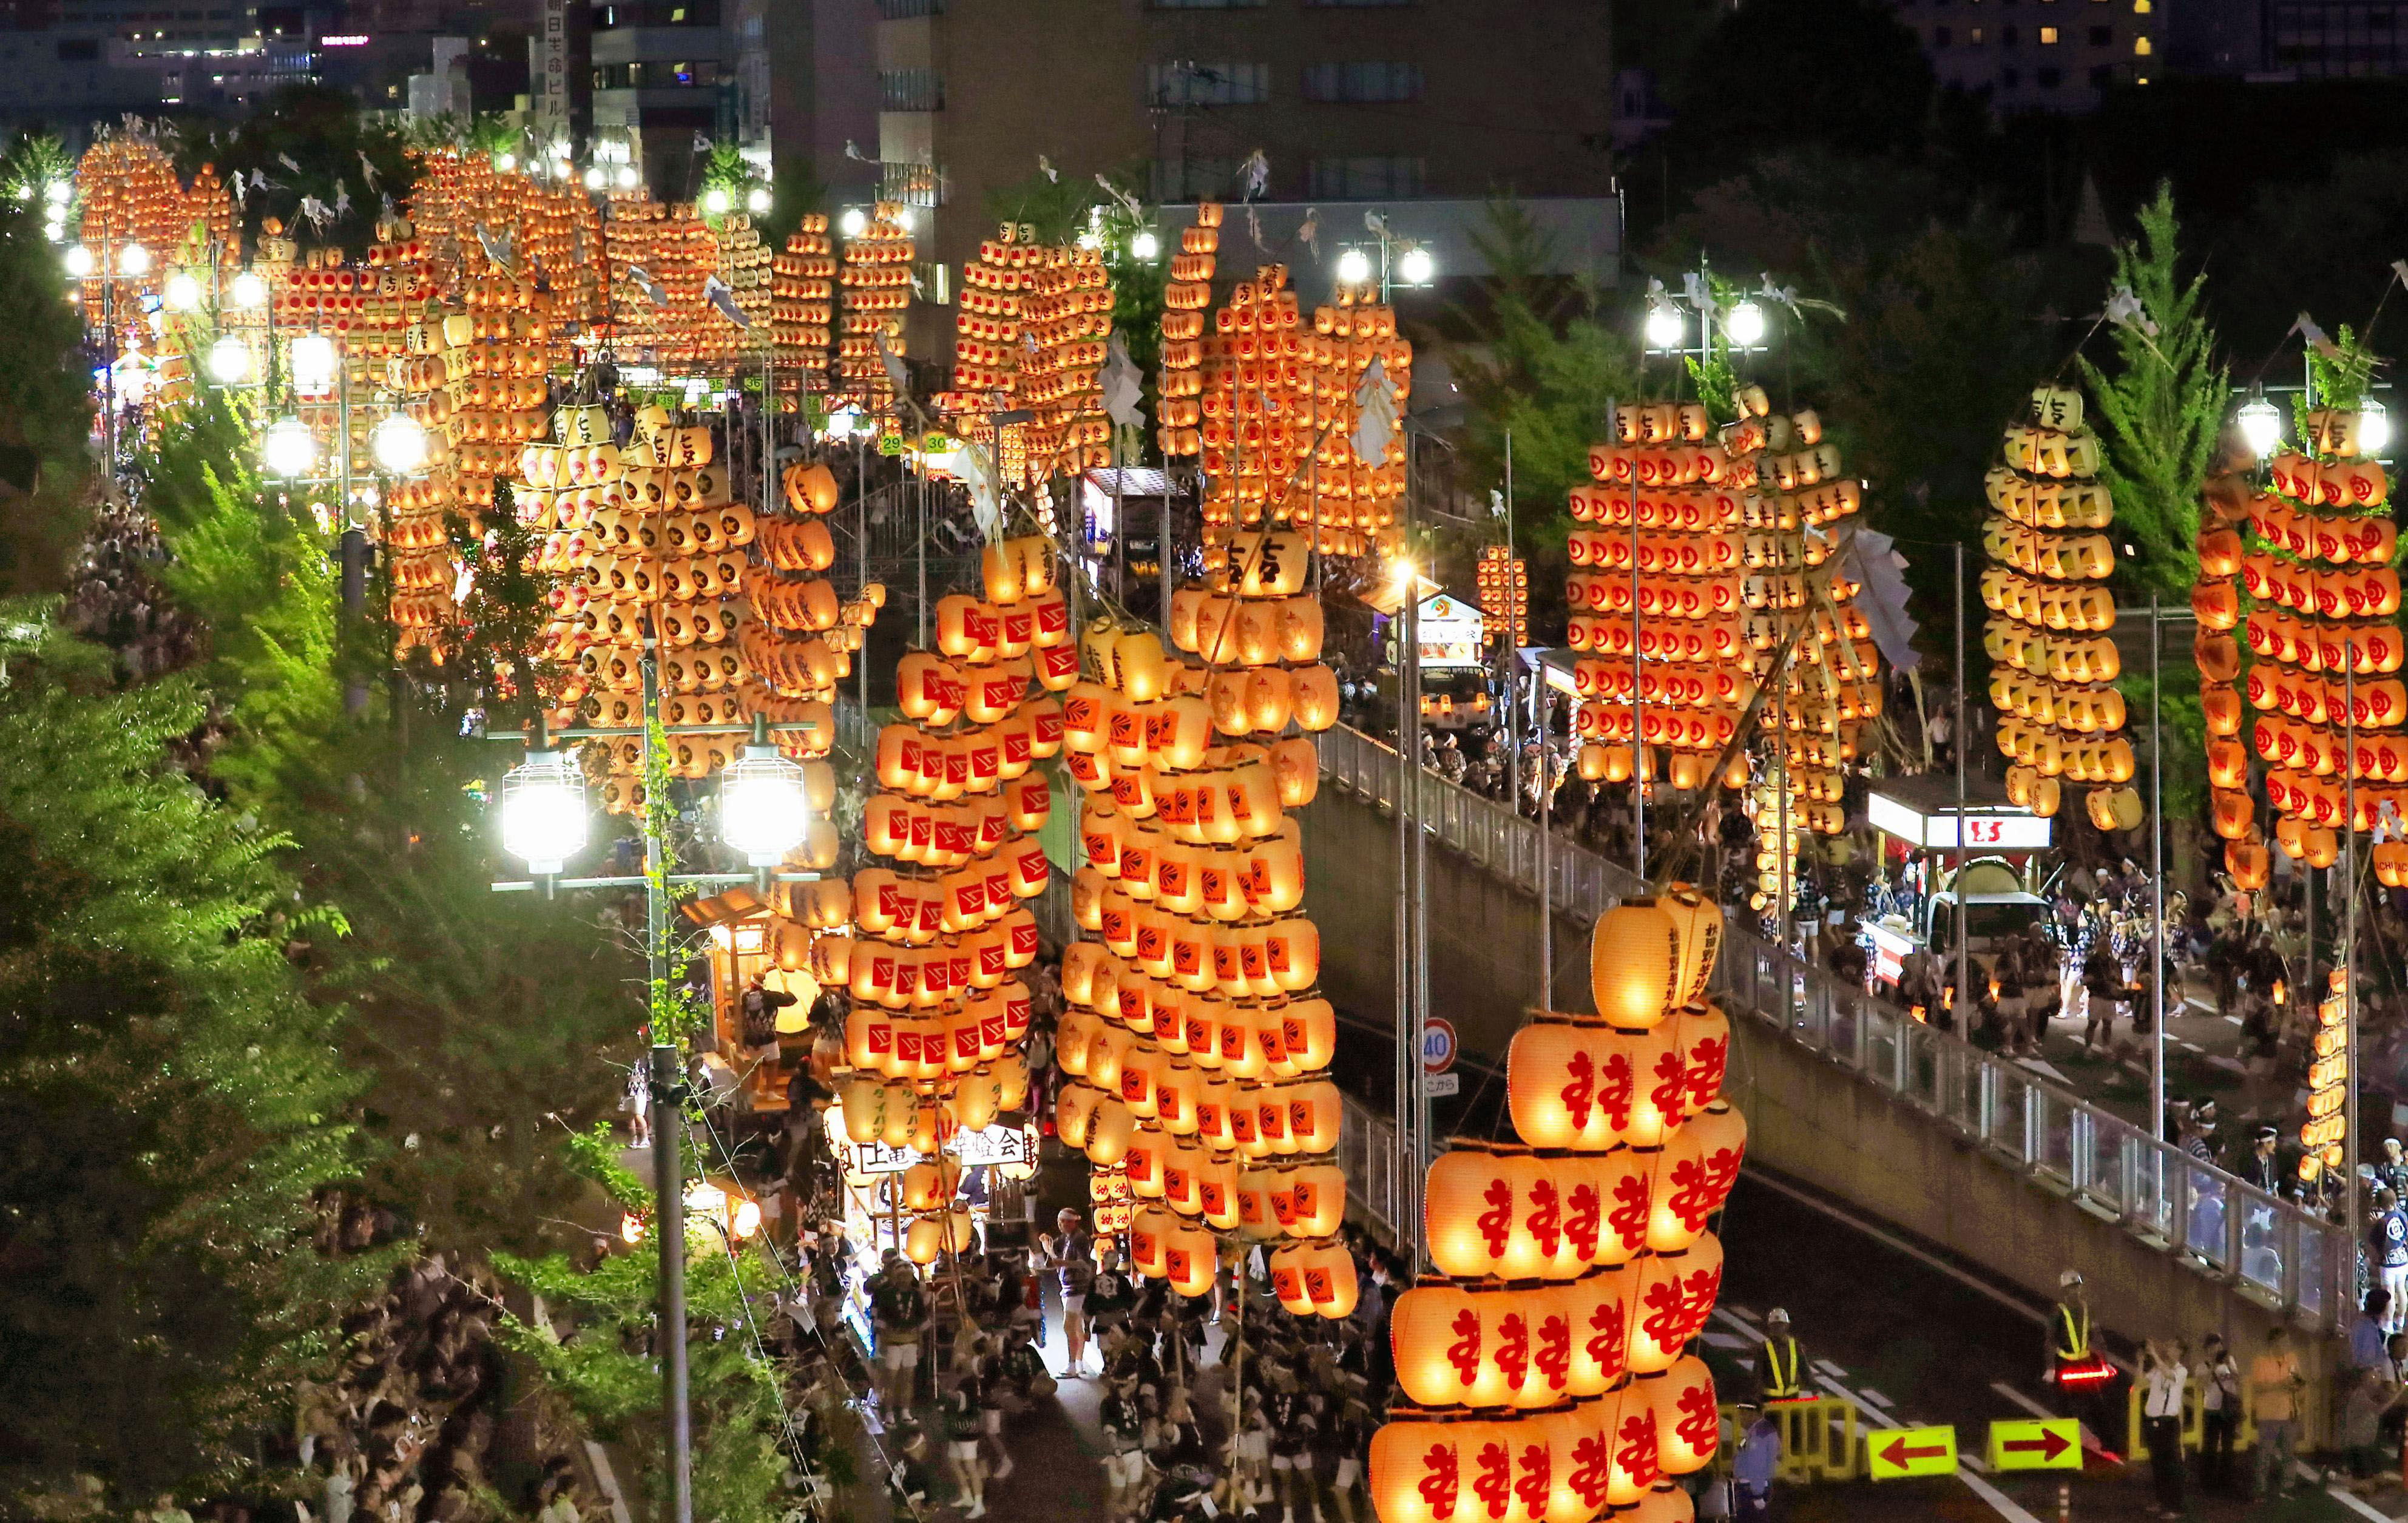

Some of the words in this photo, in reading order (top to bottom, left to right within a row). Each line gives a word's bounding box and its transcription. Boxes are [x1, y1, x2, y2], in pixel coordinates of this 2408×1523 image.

[1001, 224, 1009, 240] 七夕
[1019, 226, 1029, 241] 七夕
[385, 275, 398, 292] 七夕
[408, 275, 418, 293] 七夕
[1239, 285, 1251, 303] 七夕
[709, 380, 722, 389] 35
[746, 378, 760, 387] 36
[660, 396, 673, 405] 39
[2051, 397, 2067, 425] 七夕
[555, 416, 566, 444] 七夕
[577, 416, 592, 444] 七夕
[1617, 411, 1627, 438] 七夕
[1641, 414, 1654, 439] 七夕
[1680, 410, 1691, 437] 七夕
[2328, 420, 2348, 449] 七夕
[653, 435, 668, 464] 七夕
[680, 434, 695, 462] 七夕
[883, 437, 901, 450] 29
[928, 437, 946, 449] 30
[1260, 537, 1285, 583] 七夕
[2091, 795, 2104, 829] ALSOK
[1424, 1033, 1447, 1058] 40
[1426, 1079, 1455, 1093] こから
